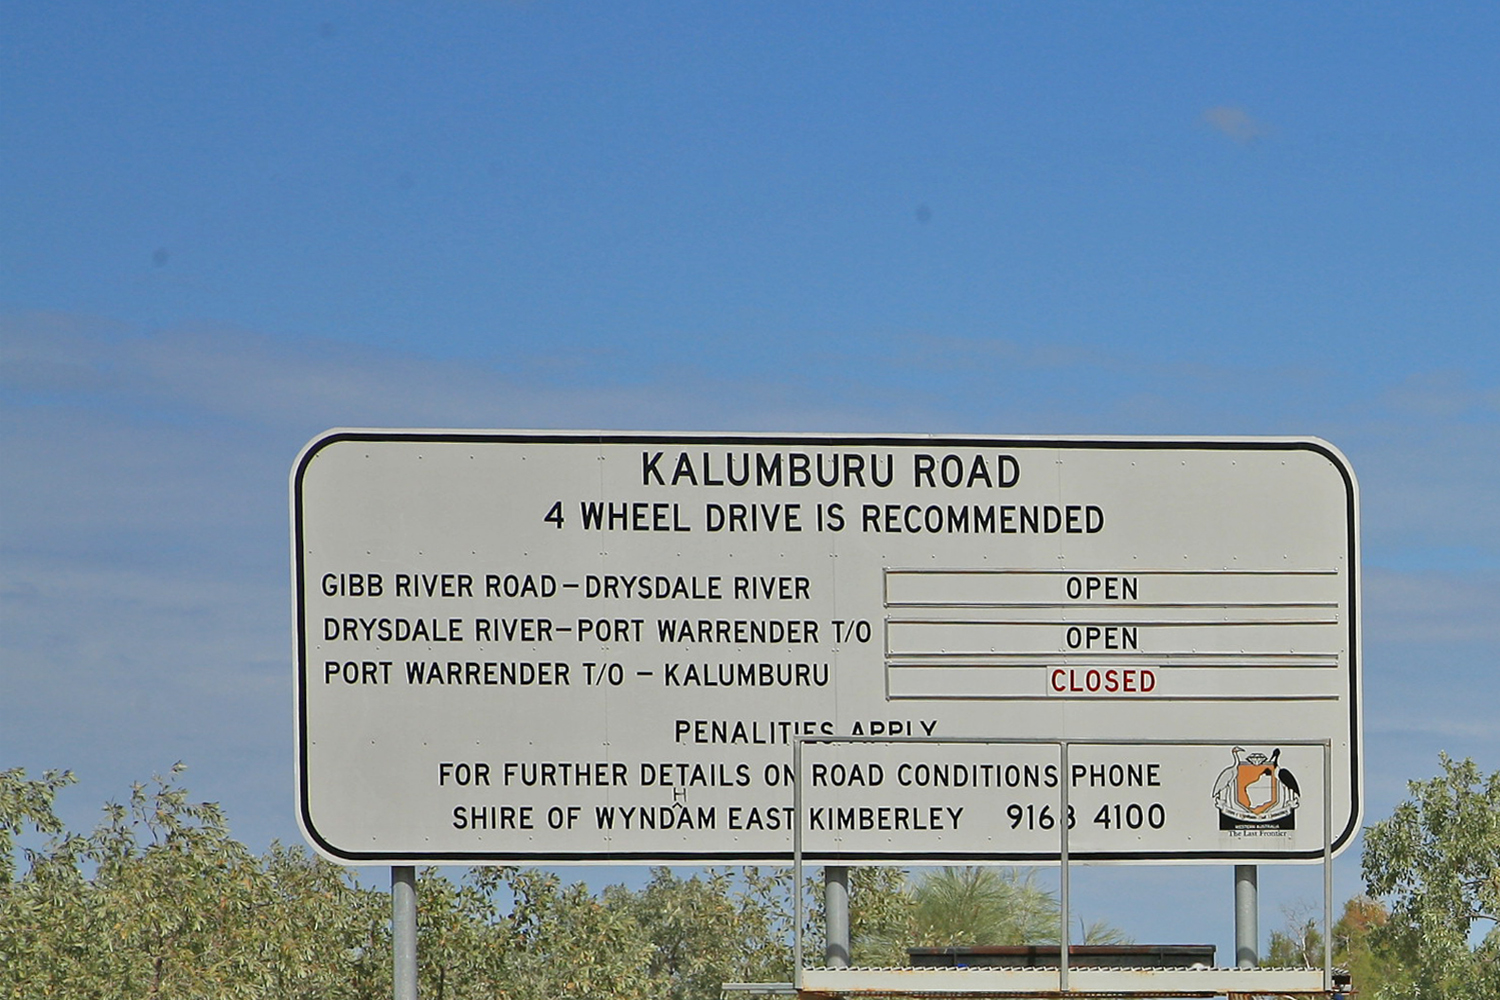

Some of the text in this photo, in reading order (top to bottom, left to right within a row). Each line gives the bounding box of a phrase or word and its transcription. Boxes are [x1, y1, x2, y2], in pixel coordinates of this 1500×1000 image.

[642, 451, 1020, 489] KALUMBURU ROAD
[543, 501, 1104, 534] 4 WHEEL DRIVE IS RECOMMENDED
[321, 573, 383, 597] GIBB
[395, 573, 473, 598] RIVER
[734, 576, 810, 600] RIVER
[1066, 576, 1138, 600] OPEN
[324, 617, 464, 642] DRYSDALE
[657, 619, 819, 644] WARRENDER
[831, 620, 872, 644] T/O
[1066, 626, 1138, 650] OPEN
[325, 661, 393, 685] PORT
[405, 661, 570, 686] WARRENDER
[582, 662, 624, 686] T/O
[664, 663, 829, 687] KALUMBURU
[1049, 669, 1158, 693] CLOSED
[675, 718, 938, 745] PENALITIES APPLY
[439, 763, 490, 786] FOR
[504, 762, 628, 787] FURTHER
[640, 763, 751, 787] DETAILS
[812, 763, 884, 787] ROAD
[897, 763, 1059, 788] CONDITIONS
[1071, 763, 1161, 788] PHONE
[452, 806, 534, 830] SHIRE
[547, 806, 582, 830] OF
[595, 806, 716, 830] WYNDAM
[726, 806, 794, 831] EAST
[809, 807, 964, 831] KIMBERLEY
[1093, 803, 1166, 830] 4100
